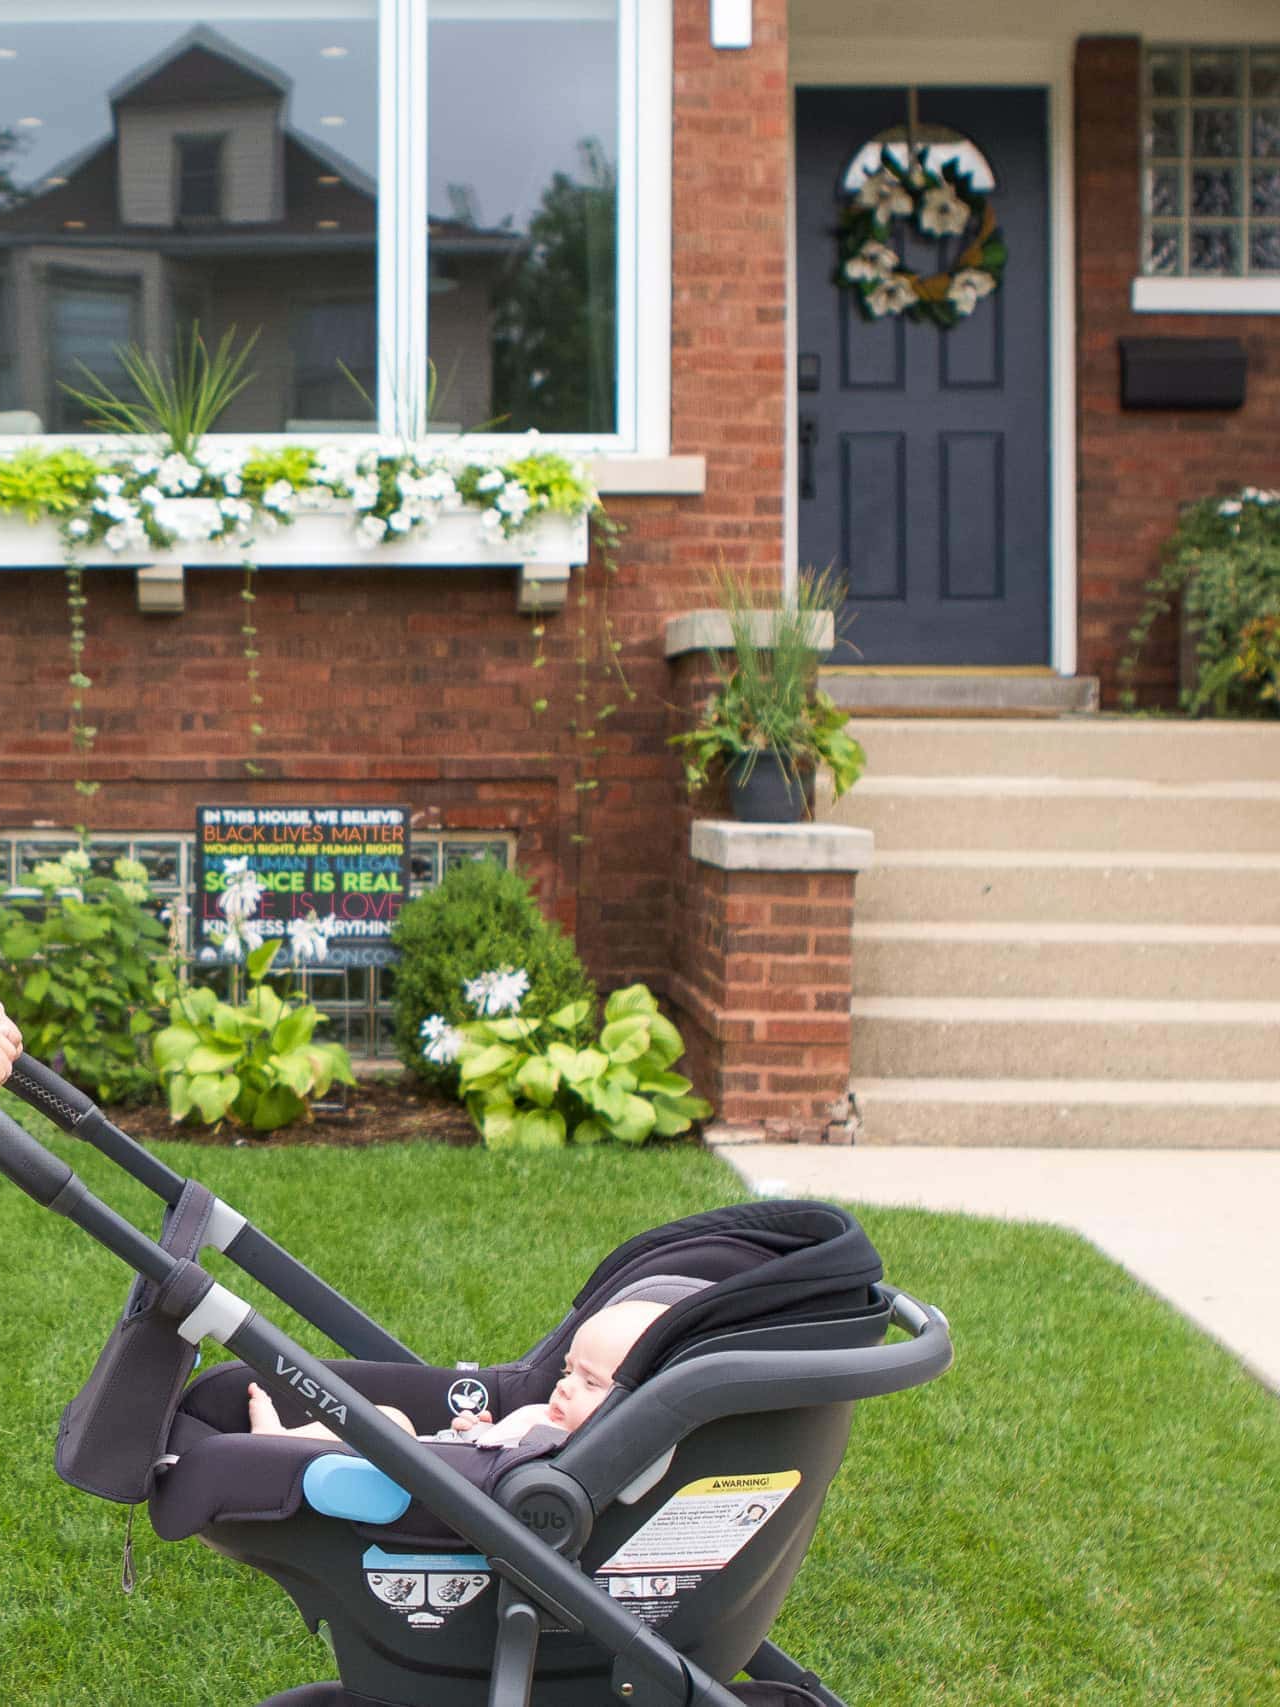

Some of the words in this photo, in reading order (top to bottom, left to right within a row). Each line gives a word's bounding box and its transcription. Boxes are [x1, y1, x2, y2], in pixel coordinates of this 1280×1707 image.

[204, 809, 221, 824] IN
[222, 809, 256, 824] THIS
[314, 809, 338, 824] WE
[204, 825, 265, 842] BLACK
[273, 825, 324, 842] LIVES
[331, 825, 404, 842] MATTER
[257, 843, 296, 855] RIGHTS
[297, 843, 318, 855] ARE
[321, 843, 362, 855] HUMAN
[365, 843, 404, 855] RIGHTS
[314, 855, 329, 871] IS
[336, 855, 402, 871] ILLEGAL
[205, 872, 305, 892] SCNCE
[313, 872, 335, 892] IS
[342, 872, 404, 892] REAL
[291, 892, 314, 919] IS
[276, 1354, 347, 1425] VISTA
[721, 1476, 770, 1488] WARNING!
